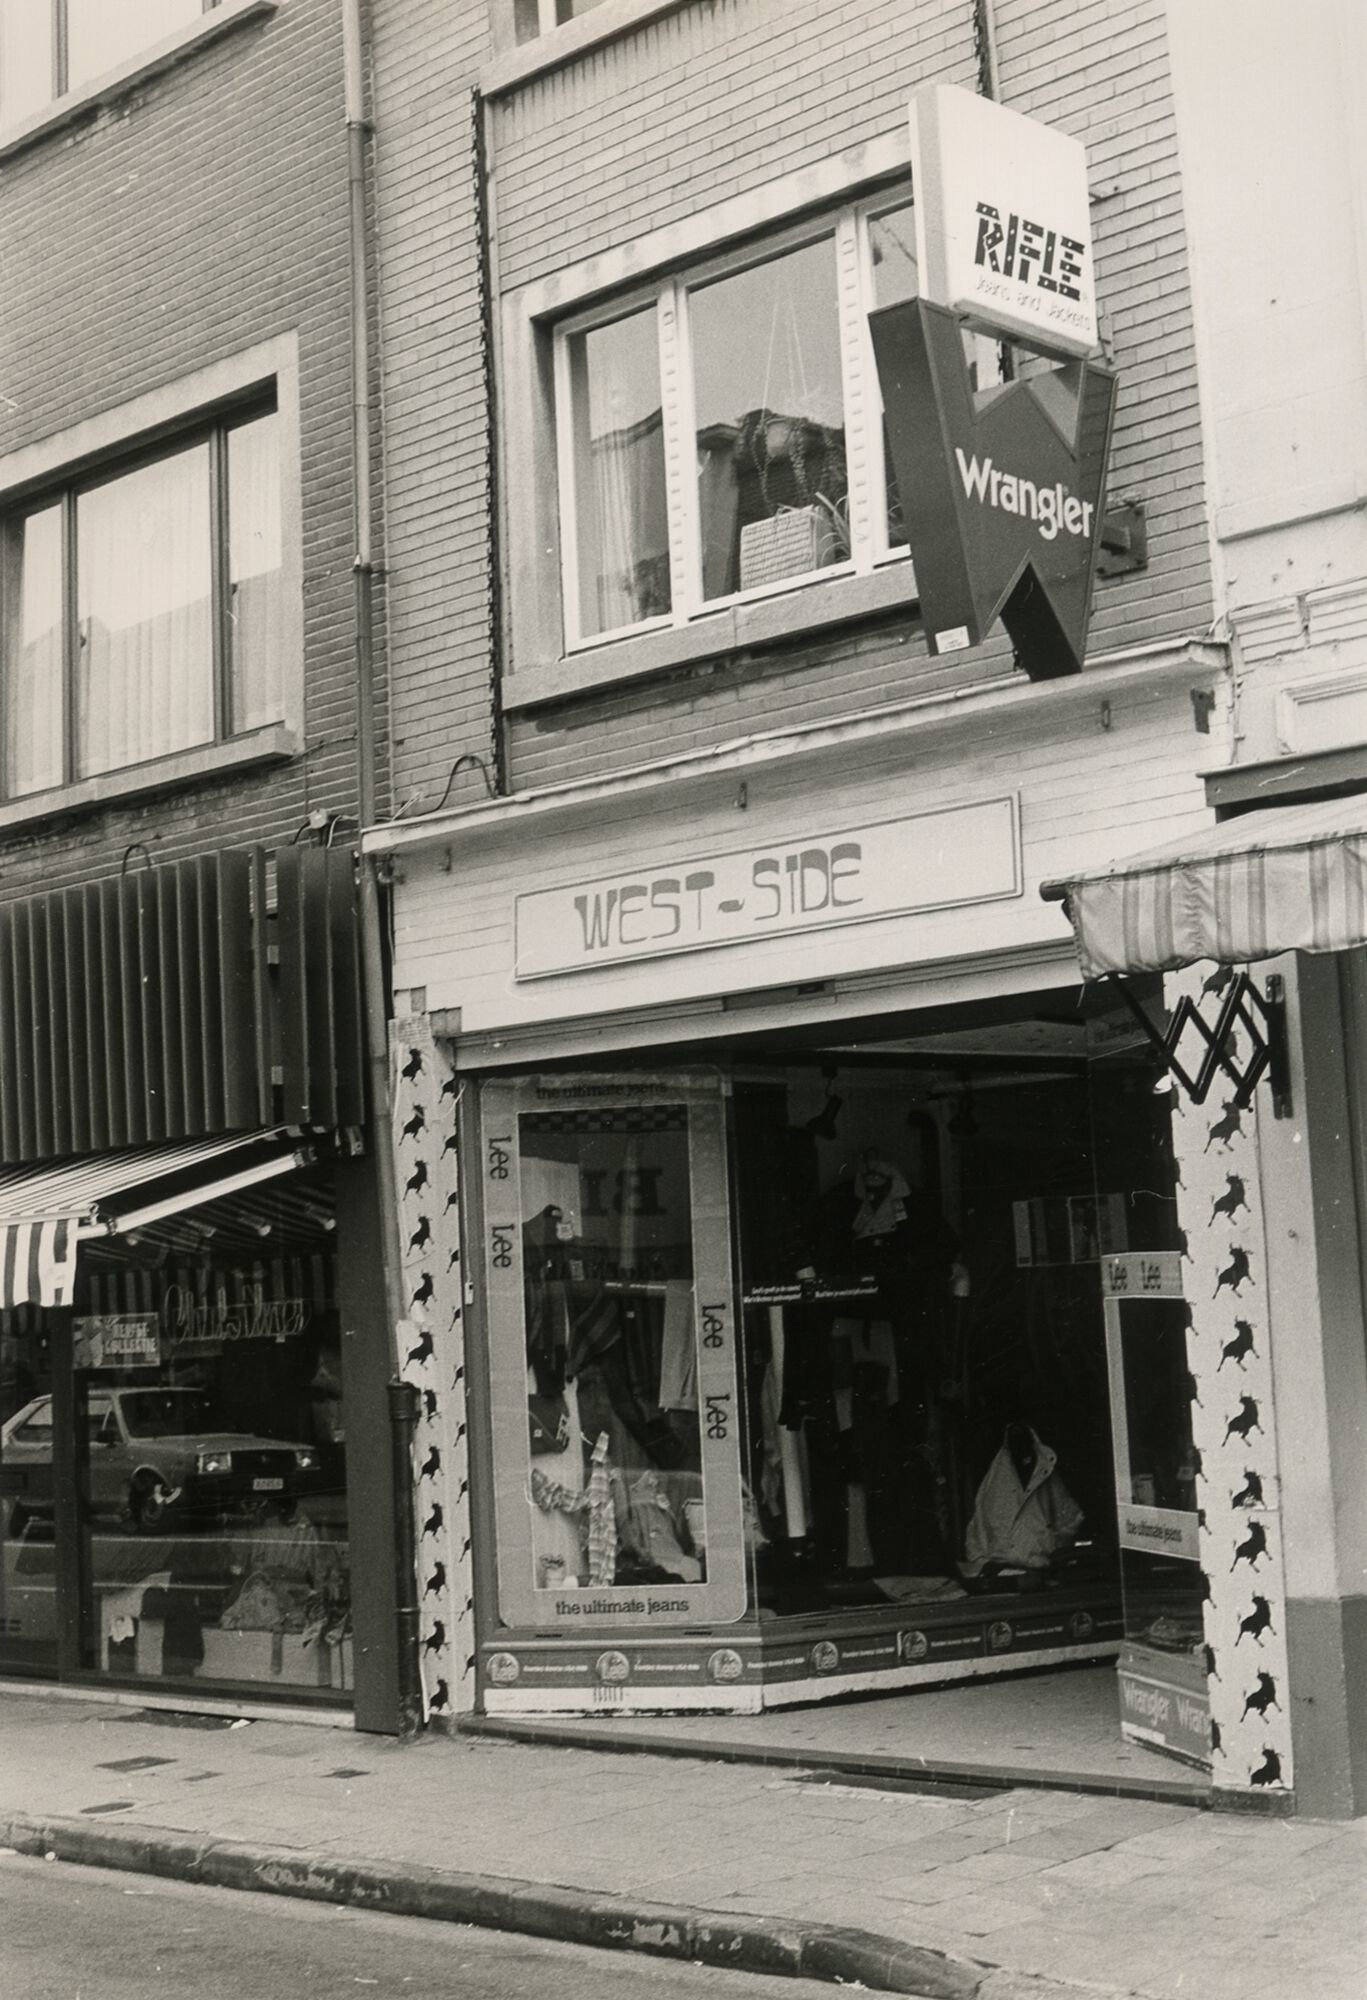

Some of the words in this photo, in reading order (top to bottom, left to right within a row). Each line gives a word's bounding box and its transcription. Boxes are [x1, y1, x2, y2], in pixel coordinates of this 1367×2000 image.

[974, 201, 1086, 302] RIFLE
[955, 447, 1094, 541] Wrangler
[488, 1135, 513, 1180] Lee
[491, 1223, 516, 1268] Lee
[1108, 1262, 1128, 1291] Lee
[1141, 1260, 1162, 1290] Lee
[702, 1303, 727, 1349] Lee
[705, 1394, 731, 1440] Lee
[555, 1600, 581, 1615] the
[582, 1599, 646, 1615] ultimate
[647, 1598, 690, 1615] jeans
[1122, 1678, 1170, 1727] Wrangler
